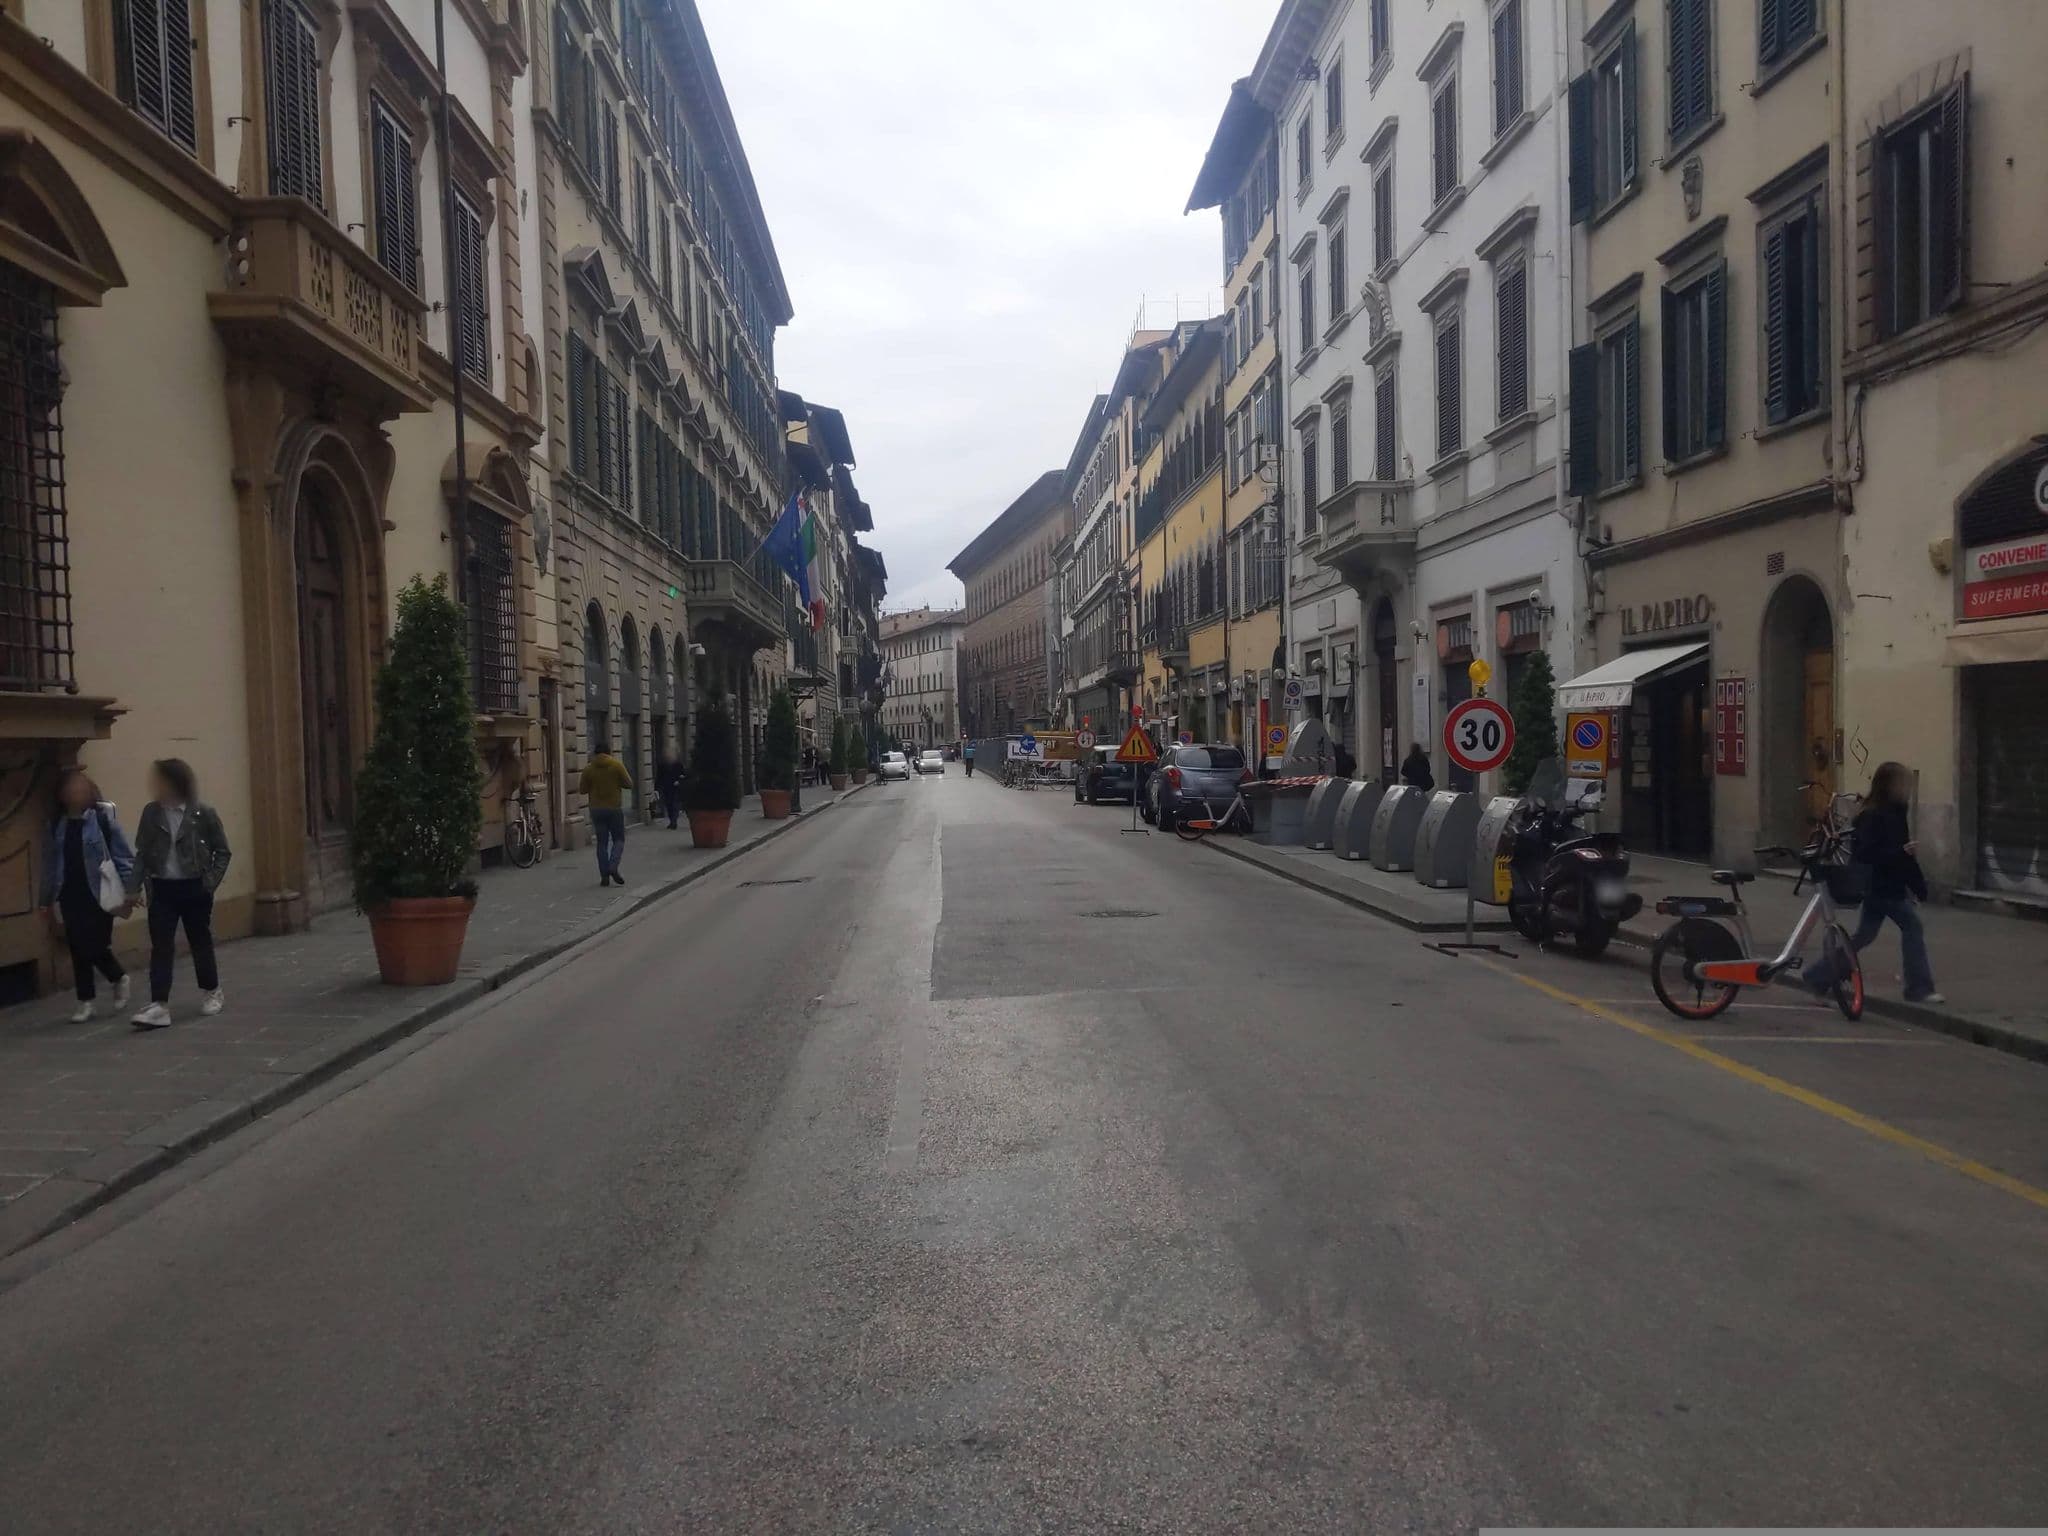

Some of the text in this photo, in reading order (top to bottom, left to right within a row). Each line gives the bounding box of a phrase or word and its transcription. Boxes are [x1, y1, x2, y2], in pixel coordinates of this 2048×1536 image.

[1979, 544, 2047, 569] CONVENIE
[1621, 593, 1710, 635] IL PAPIRO
[1461, 718, 1501, 752] 30
